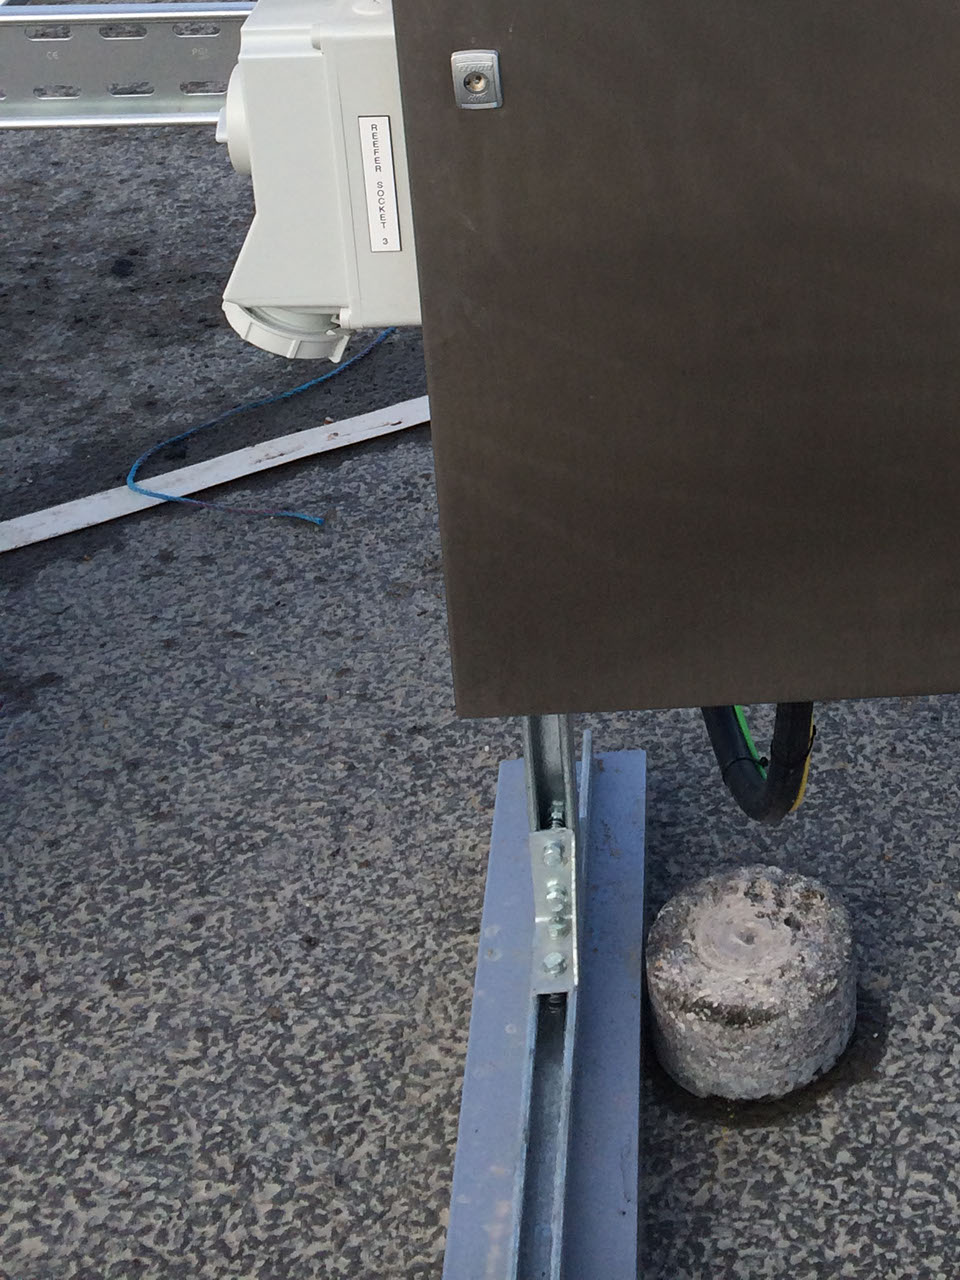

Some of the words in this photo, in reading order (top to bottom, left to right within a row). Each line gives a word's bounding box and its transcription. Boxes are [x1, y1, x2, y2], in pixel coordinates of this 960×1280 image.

[370, 123, 382, 173] REEFER
[376, 181, 387, 229] SOCKET
[382, 237, 389, 246] 3
